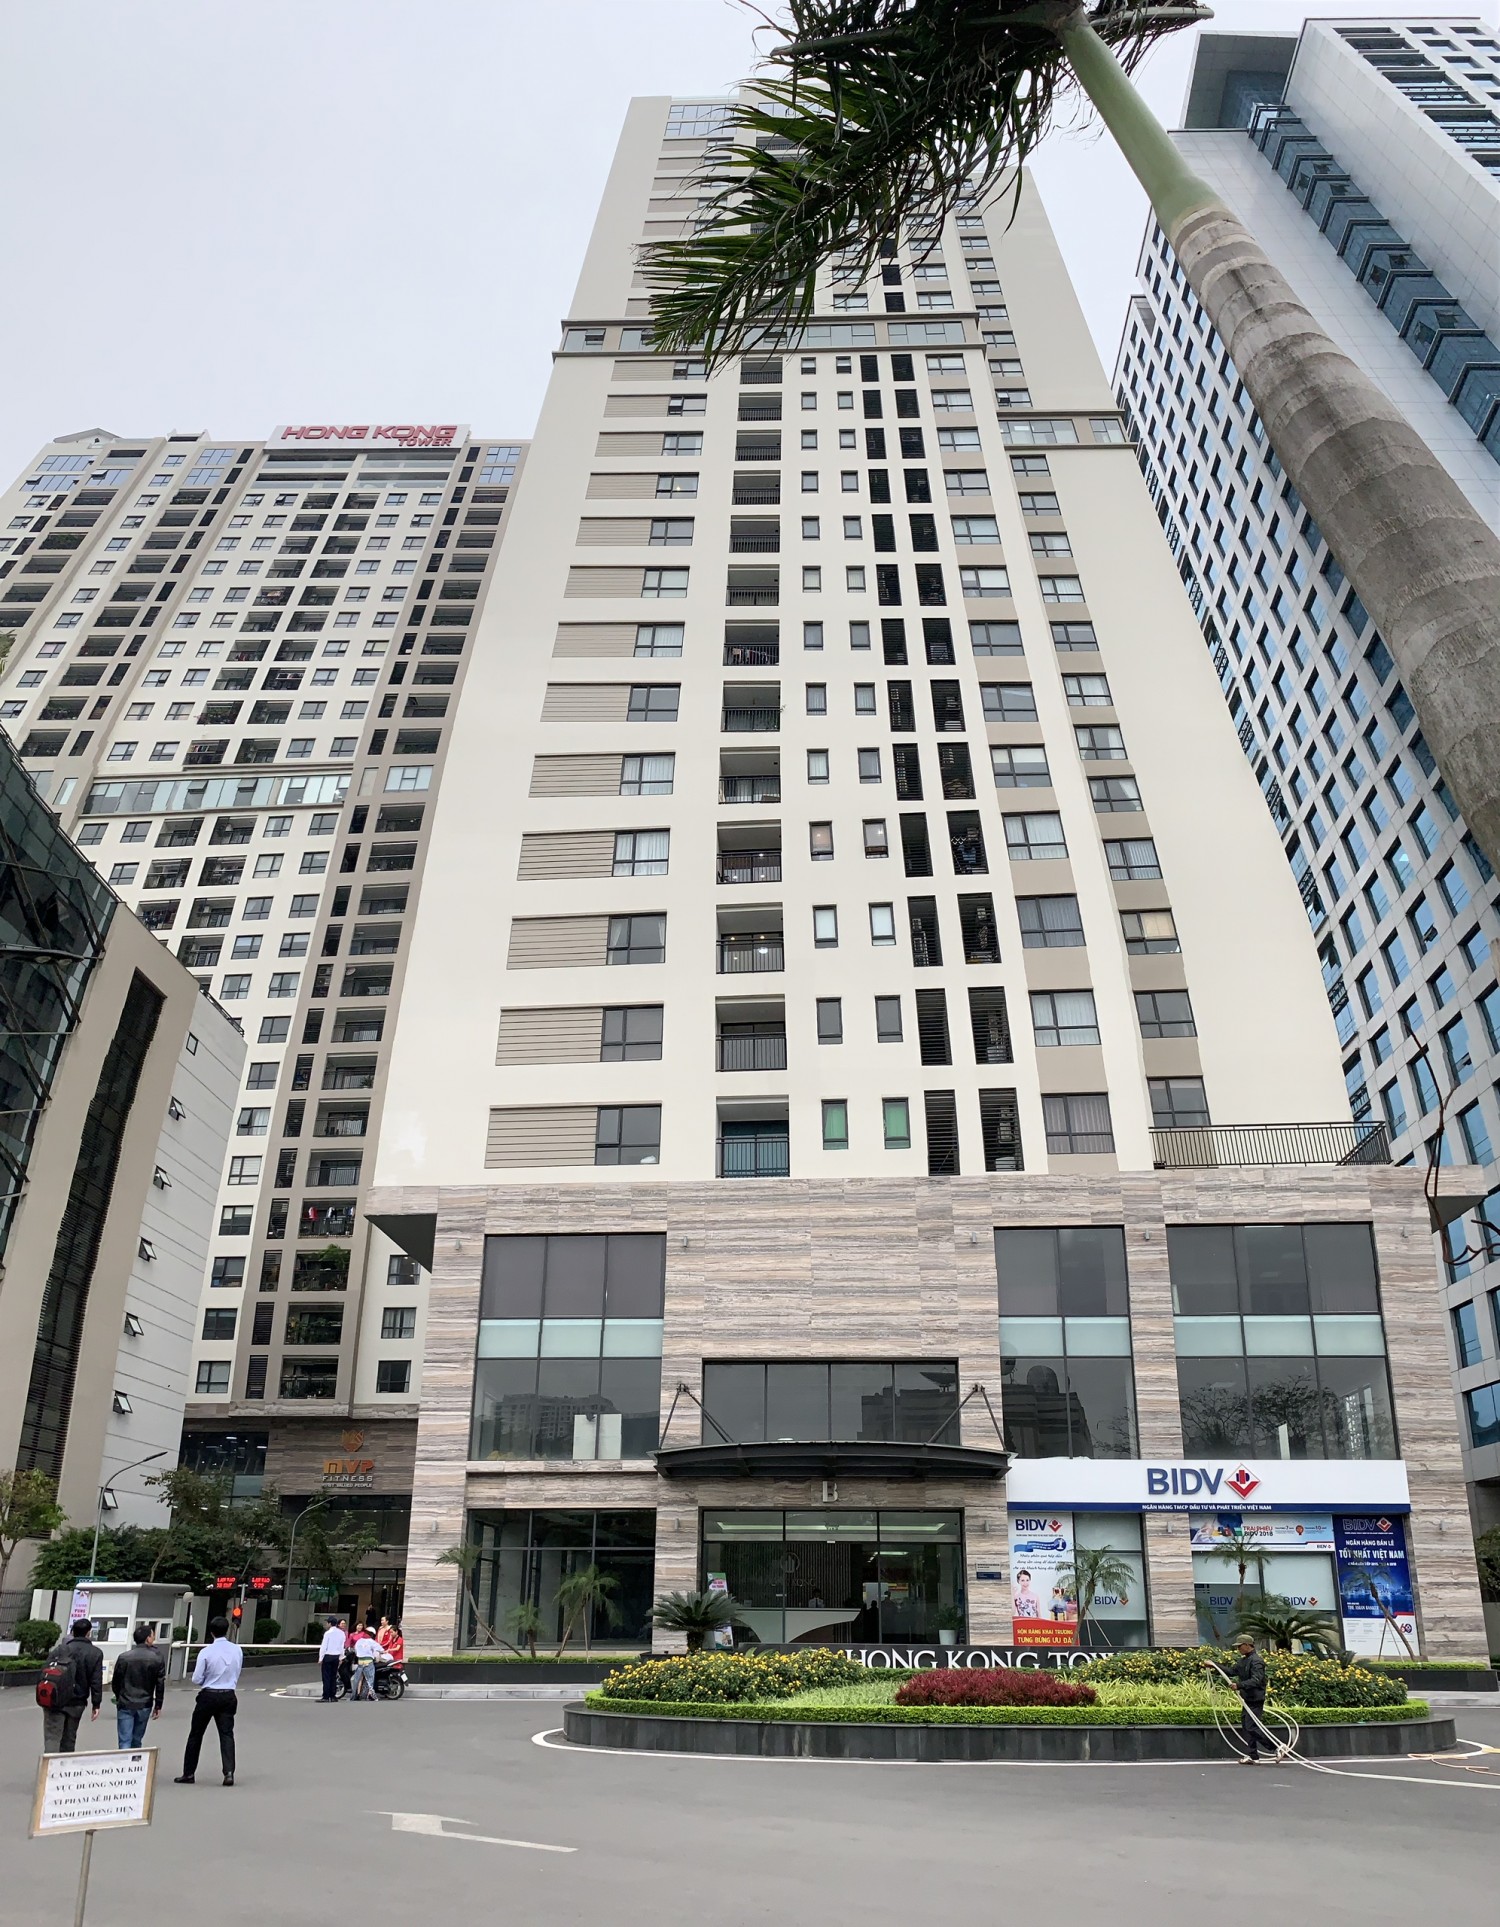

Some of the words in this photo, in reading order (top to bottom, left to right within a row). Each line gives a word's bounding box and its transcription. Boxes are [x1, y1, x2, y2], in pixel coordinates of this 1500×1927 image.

[281, 425, 369, 439] HONG
[372, 425, 457, 439] KONG
[398, 437, 451, 447] TOWER
[323, 1458, 374, 1474] MVP
[1146, 1468, 1224, 1495] BIDV
[822, 1481, 839, 1502] B
[1174, 1503, 1188, 1511] TMCP
[1260, 1503, 1272, 1511] NAM
[1015, 1519, 1047, 1531] BIDV
[1342, 1518, 1376, 1531] BIDV
[1388, 1550, 1405, 1559] NAM
[1094, 1596, 1118, 1605] BIDV
[1209, 1596, 1234, 1606] BIDV
[847, 1648, 938, 1669] HONG
[945, 1650, 1040, 1669] KONG
